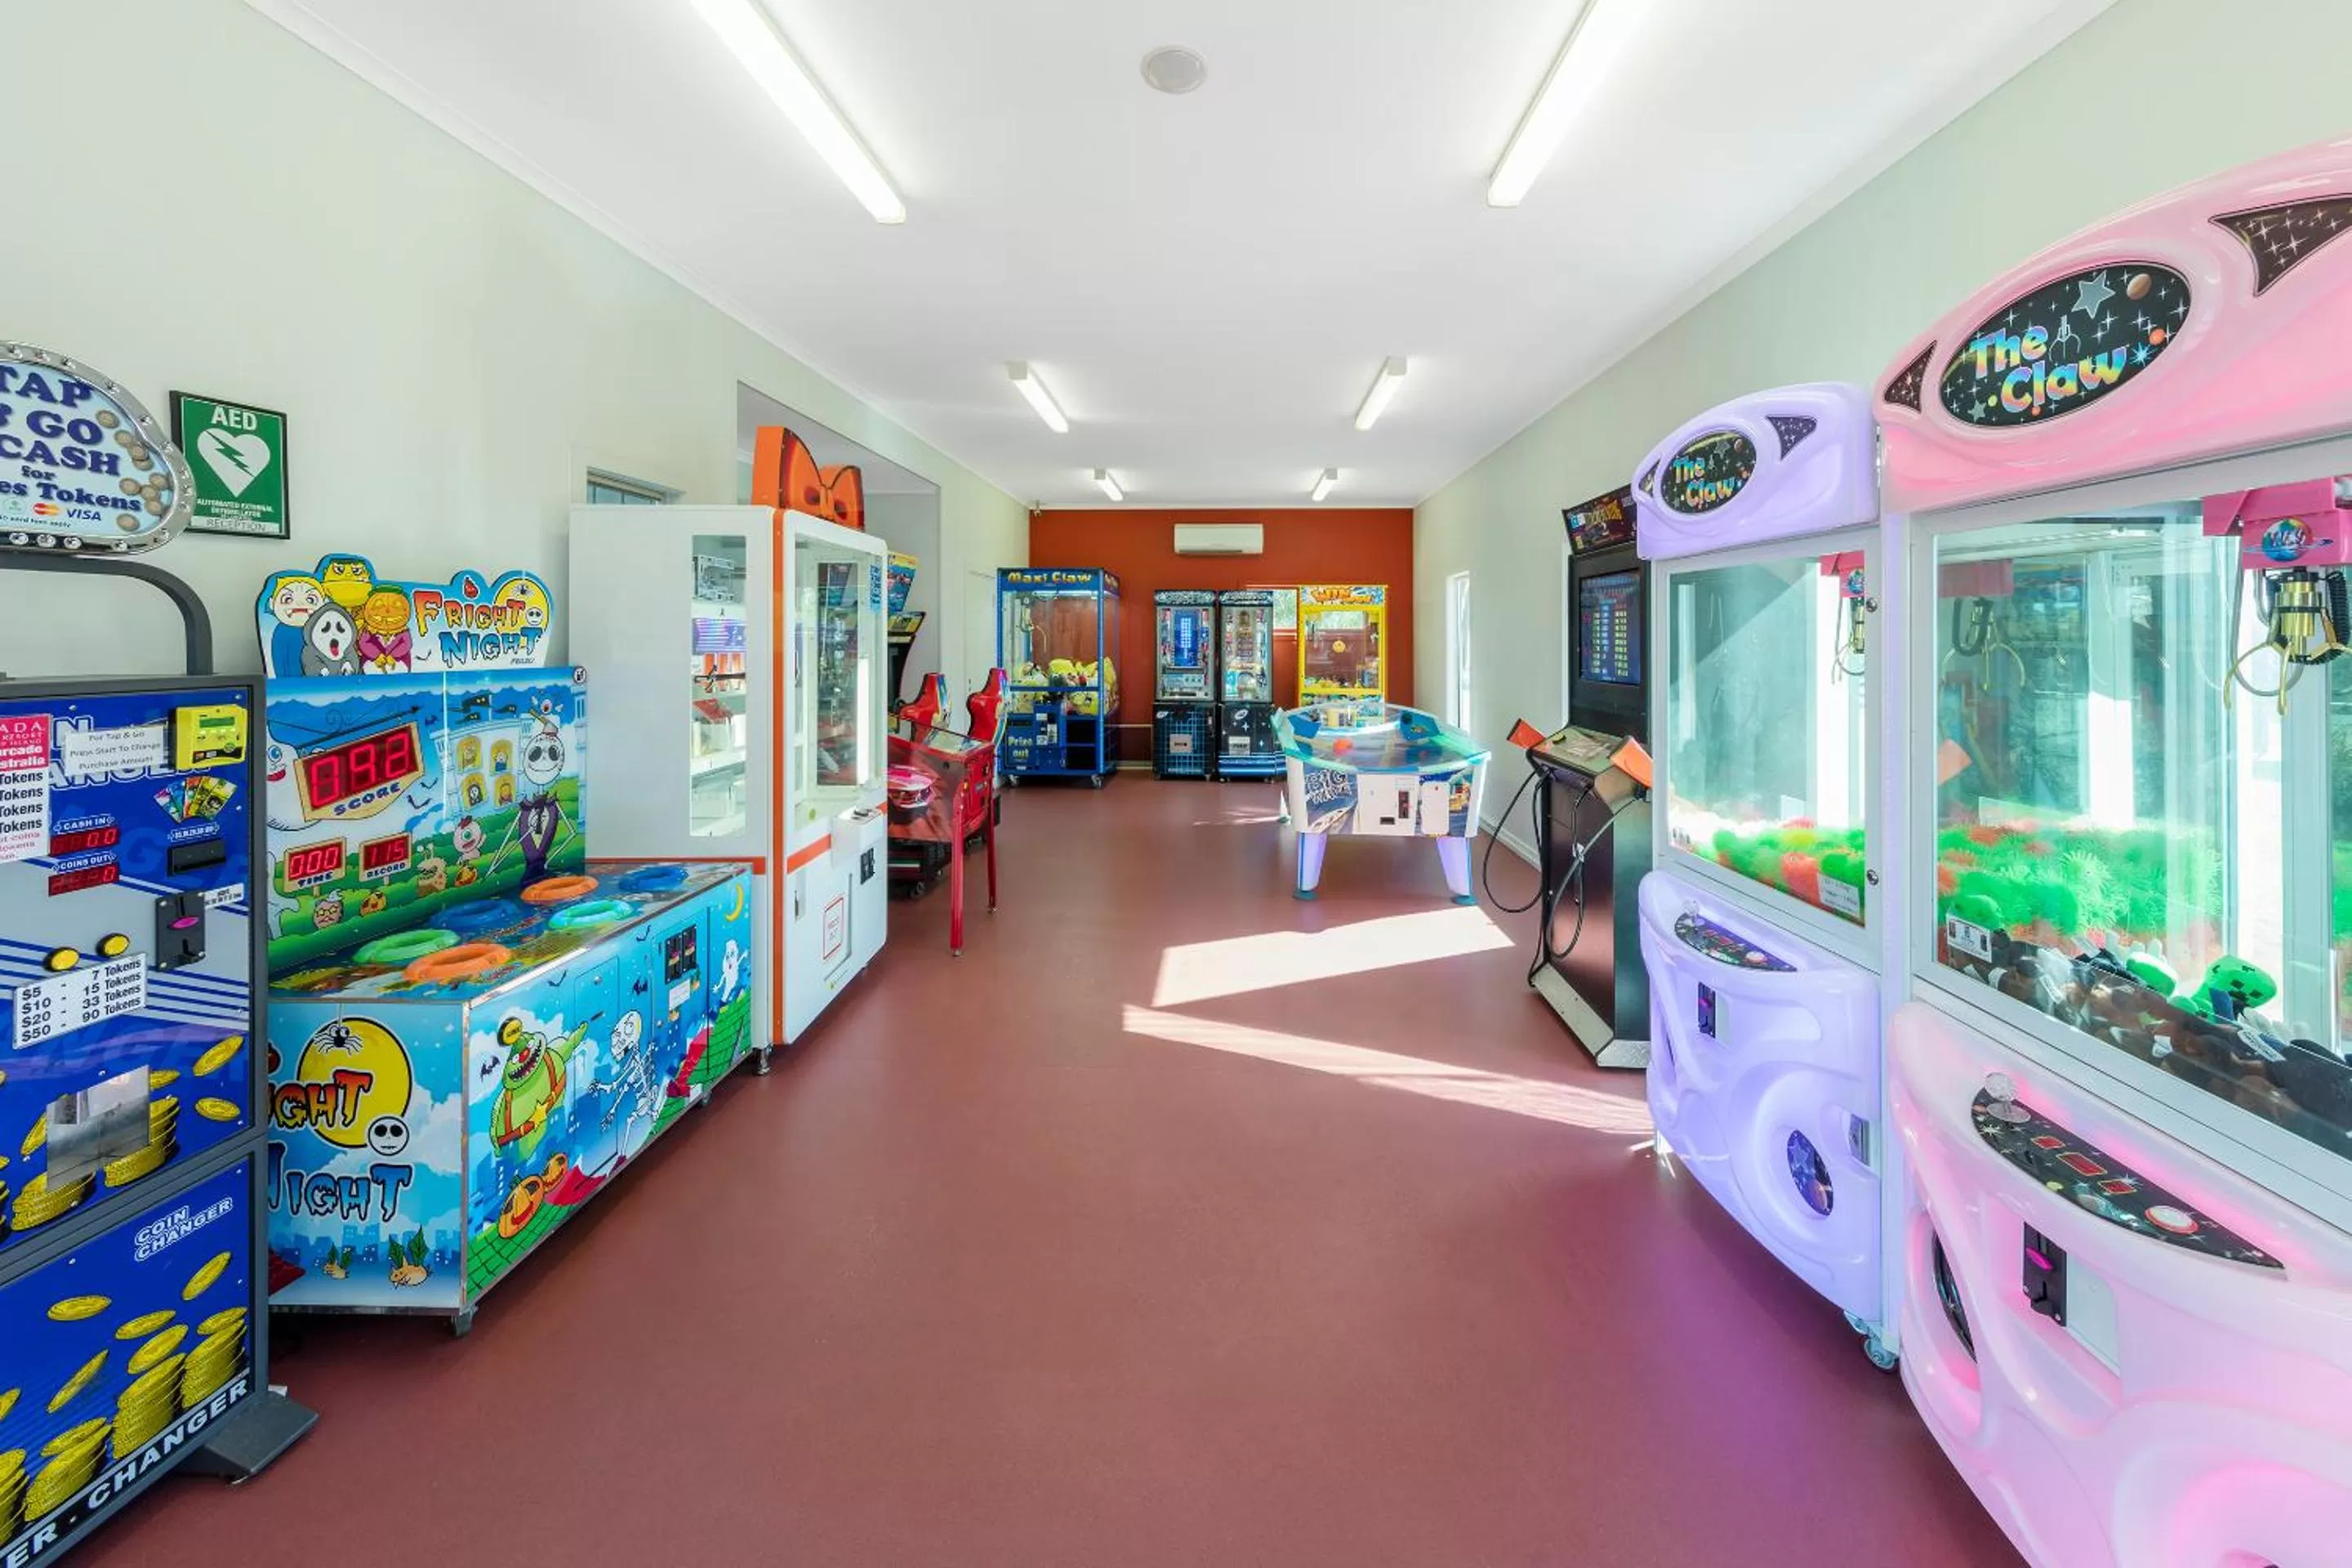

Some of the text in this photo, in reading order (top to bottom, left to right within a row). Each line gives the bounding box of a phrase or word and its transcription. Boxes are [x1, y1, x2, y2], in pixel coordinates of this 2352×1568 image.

[1968, 326, 2049, 380] The
[2001, 346, 2127, 413] Claw
[26, 410, 104, 446] GO
[212, 406, 257, 430] AED
[0, 433, 121, 476] CASH
[21, 466, 56, 480] for
[1673, 457, 1705, 483] The
[36, 482, 142, 511] Tokens
[1686, 476, 1735, 507] Claw
[67, 509, 101, 521] VISA
[207, 518, 265, 531] RECEPTION
[1008, 572, 1048, 583] Maxi
[1051, 572, 1092, 583] Claw
[78, 760, 118, 770] Purchase
[95, 746, 116, 755] Start
[1013, 748, 1029, 759] out
[333, 782, 400, 816] SCORE
[64, 817, 105, 830] CASH IN
[60, 854, 108, 870] COINS OUT
[367, 862, 405, 877] RECORD
[297, 871, 333, 887] TIME
[22, 987, 42, 1000] $5
[92, 969, 100, 981] 7
[105, 960, 141, 977] Tokens
[22, 997, 51, 1014] $10
[83, 982, 100, 996] 15
[105, 972, 141, 989] Tokens
[21, 1010, 51, 1029] $20
[82, 995, 100, 1009] 33
[105, 984, 141, 1003] Tokens
[21, 1024, 51, 1043] $50
[82, 1008, 100, 1022] 90
[105, 996, 141, 1016] Tokens
[136, 1207, 188, 1245] COIN
[136, 1199, 233, 1260] CHANGER
[6, 1379, 248, 1568] ER CHANGER
